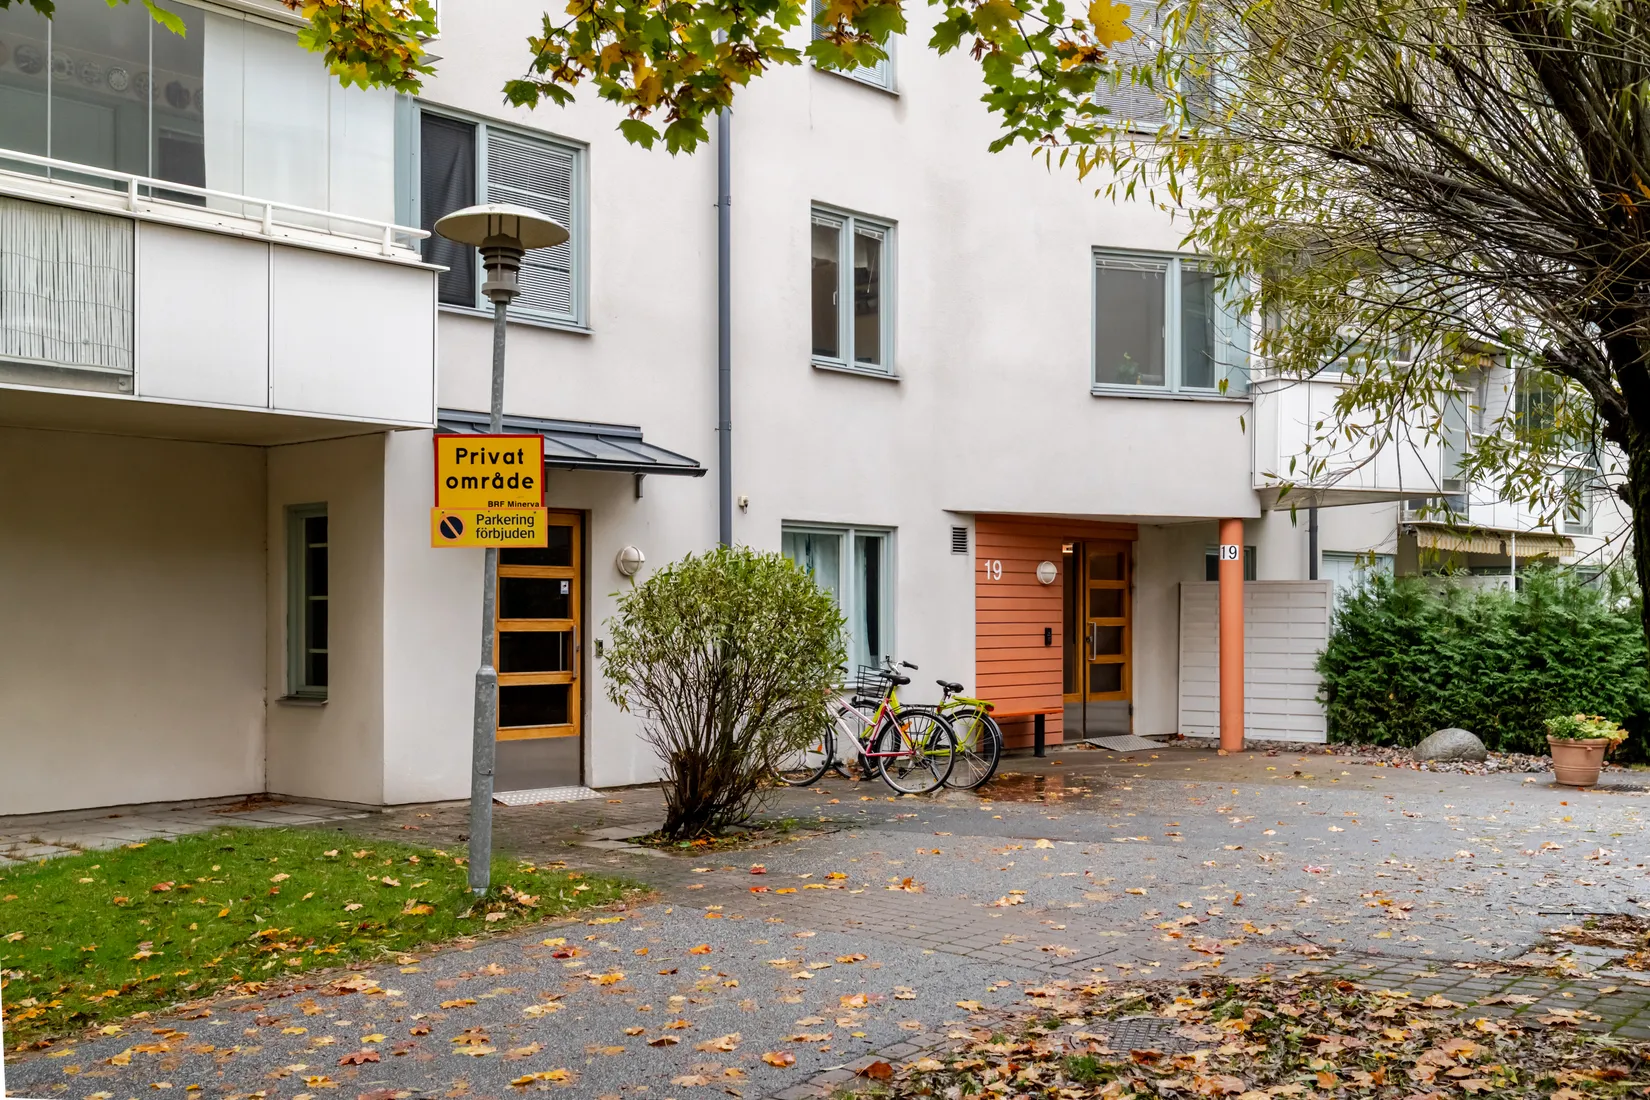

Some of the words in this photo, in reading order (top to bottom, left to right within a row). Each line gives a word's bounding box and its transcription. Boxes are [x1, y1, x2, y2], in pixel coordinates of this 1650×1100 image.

[456, 447, 524, 465] Privat
[446, 472, 534, 489] område
[476, 514, 535, 528] Parkering
[476, 528, 535, 541] förbjuden
[1221, 545, 1238, 560] 19
[984, 559, 1003, 581] 19
